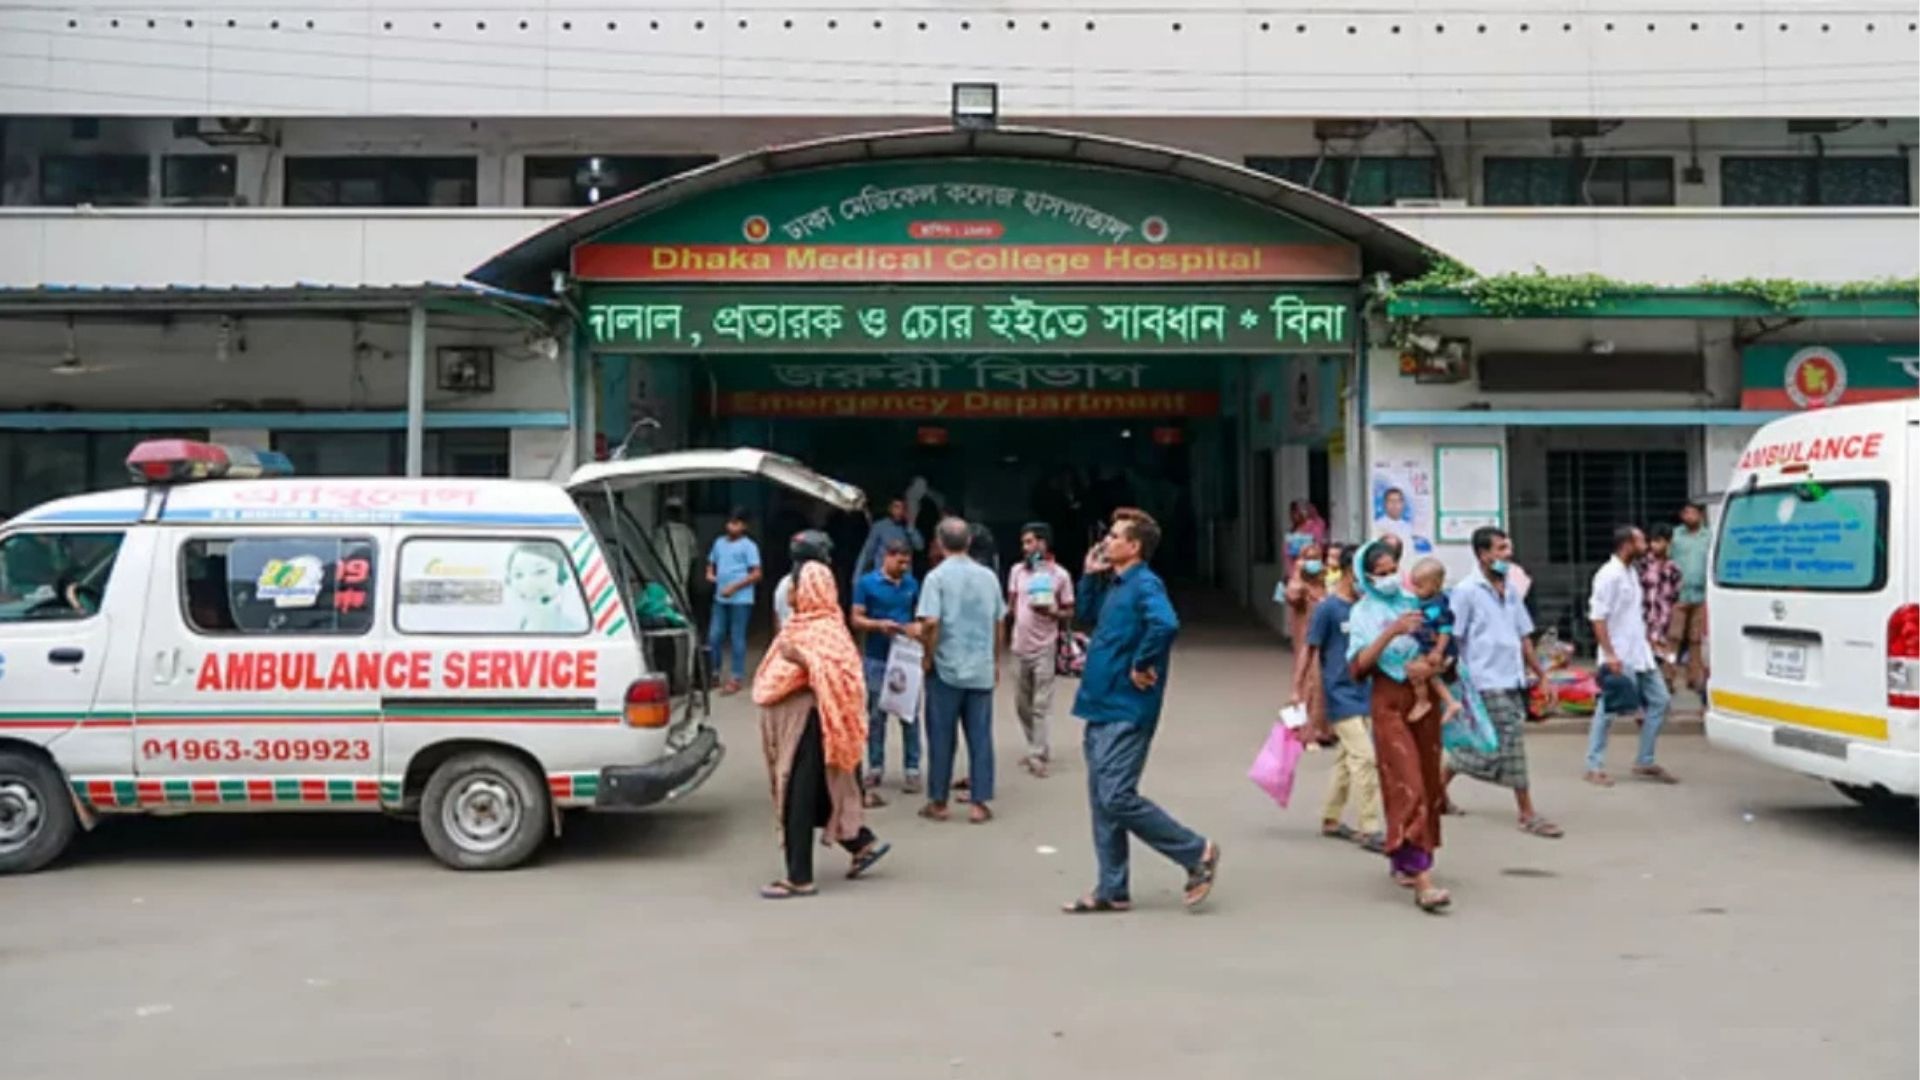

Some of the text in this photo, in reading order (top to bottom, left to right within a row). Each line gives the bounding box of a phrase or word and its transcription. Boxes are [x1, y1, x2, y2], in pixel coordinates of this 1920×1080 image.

[652, 247, 1262, 274] Dhaka Medical College Hospital
[712, 304, 844, 341] প্রতারক
[858, 308, 887, 338] ও
[901, 305, 974, 341] চোর
[983, 294, 1089, 344] হইতে
[1097, 305, 1226, 343] সাবধান
[1269, 294, 1347, 343] বিনা
[733, 392, 1187, 415] Emergency Department
[1739, 433, 1884, 471] AMBULANCE
[196, 650, 597, 691] AMBULANCE SERVICE
[143, 739, 371, 762] 01963-309923
